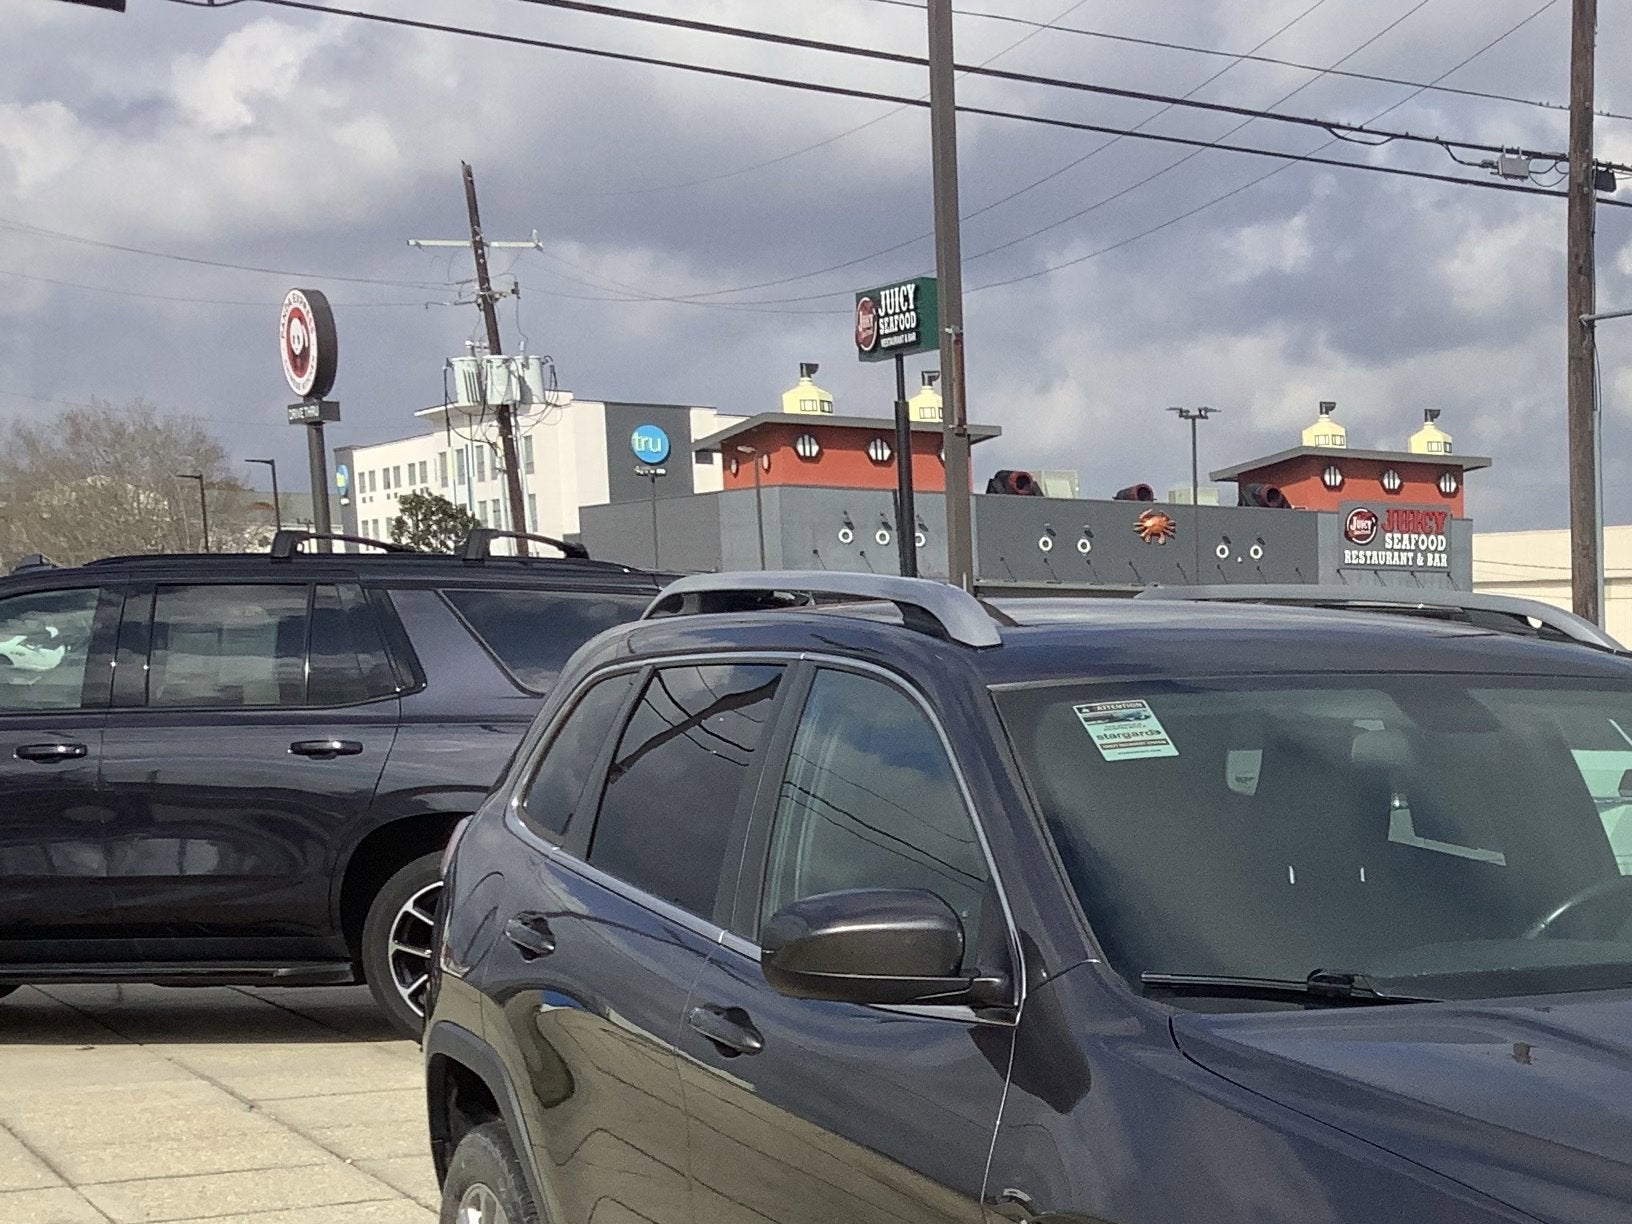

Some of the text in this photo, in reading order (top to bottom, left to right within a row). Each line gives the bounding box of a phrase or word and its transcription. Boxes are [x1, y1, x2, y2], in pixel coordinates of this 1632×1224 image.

[878, 283, 916, 316] JUICY
[879, 311, 917, 335] SEAFOOD
[631, 431, 662, 453] tru
[1381, 508, 1448, 534] JUICY
[1385, 533, 1447, 551] SEAFOOD
[1344, 550, 1448, 567] RESTAURANT & BAR
[1096, 703, 1143, 711] ATTENTION
